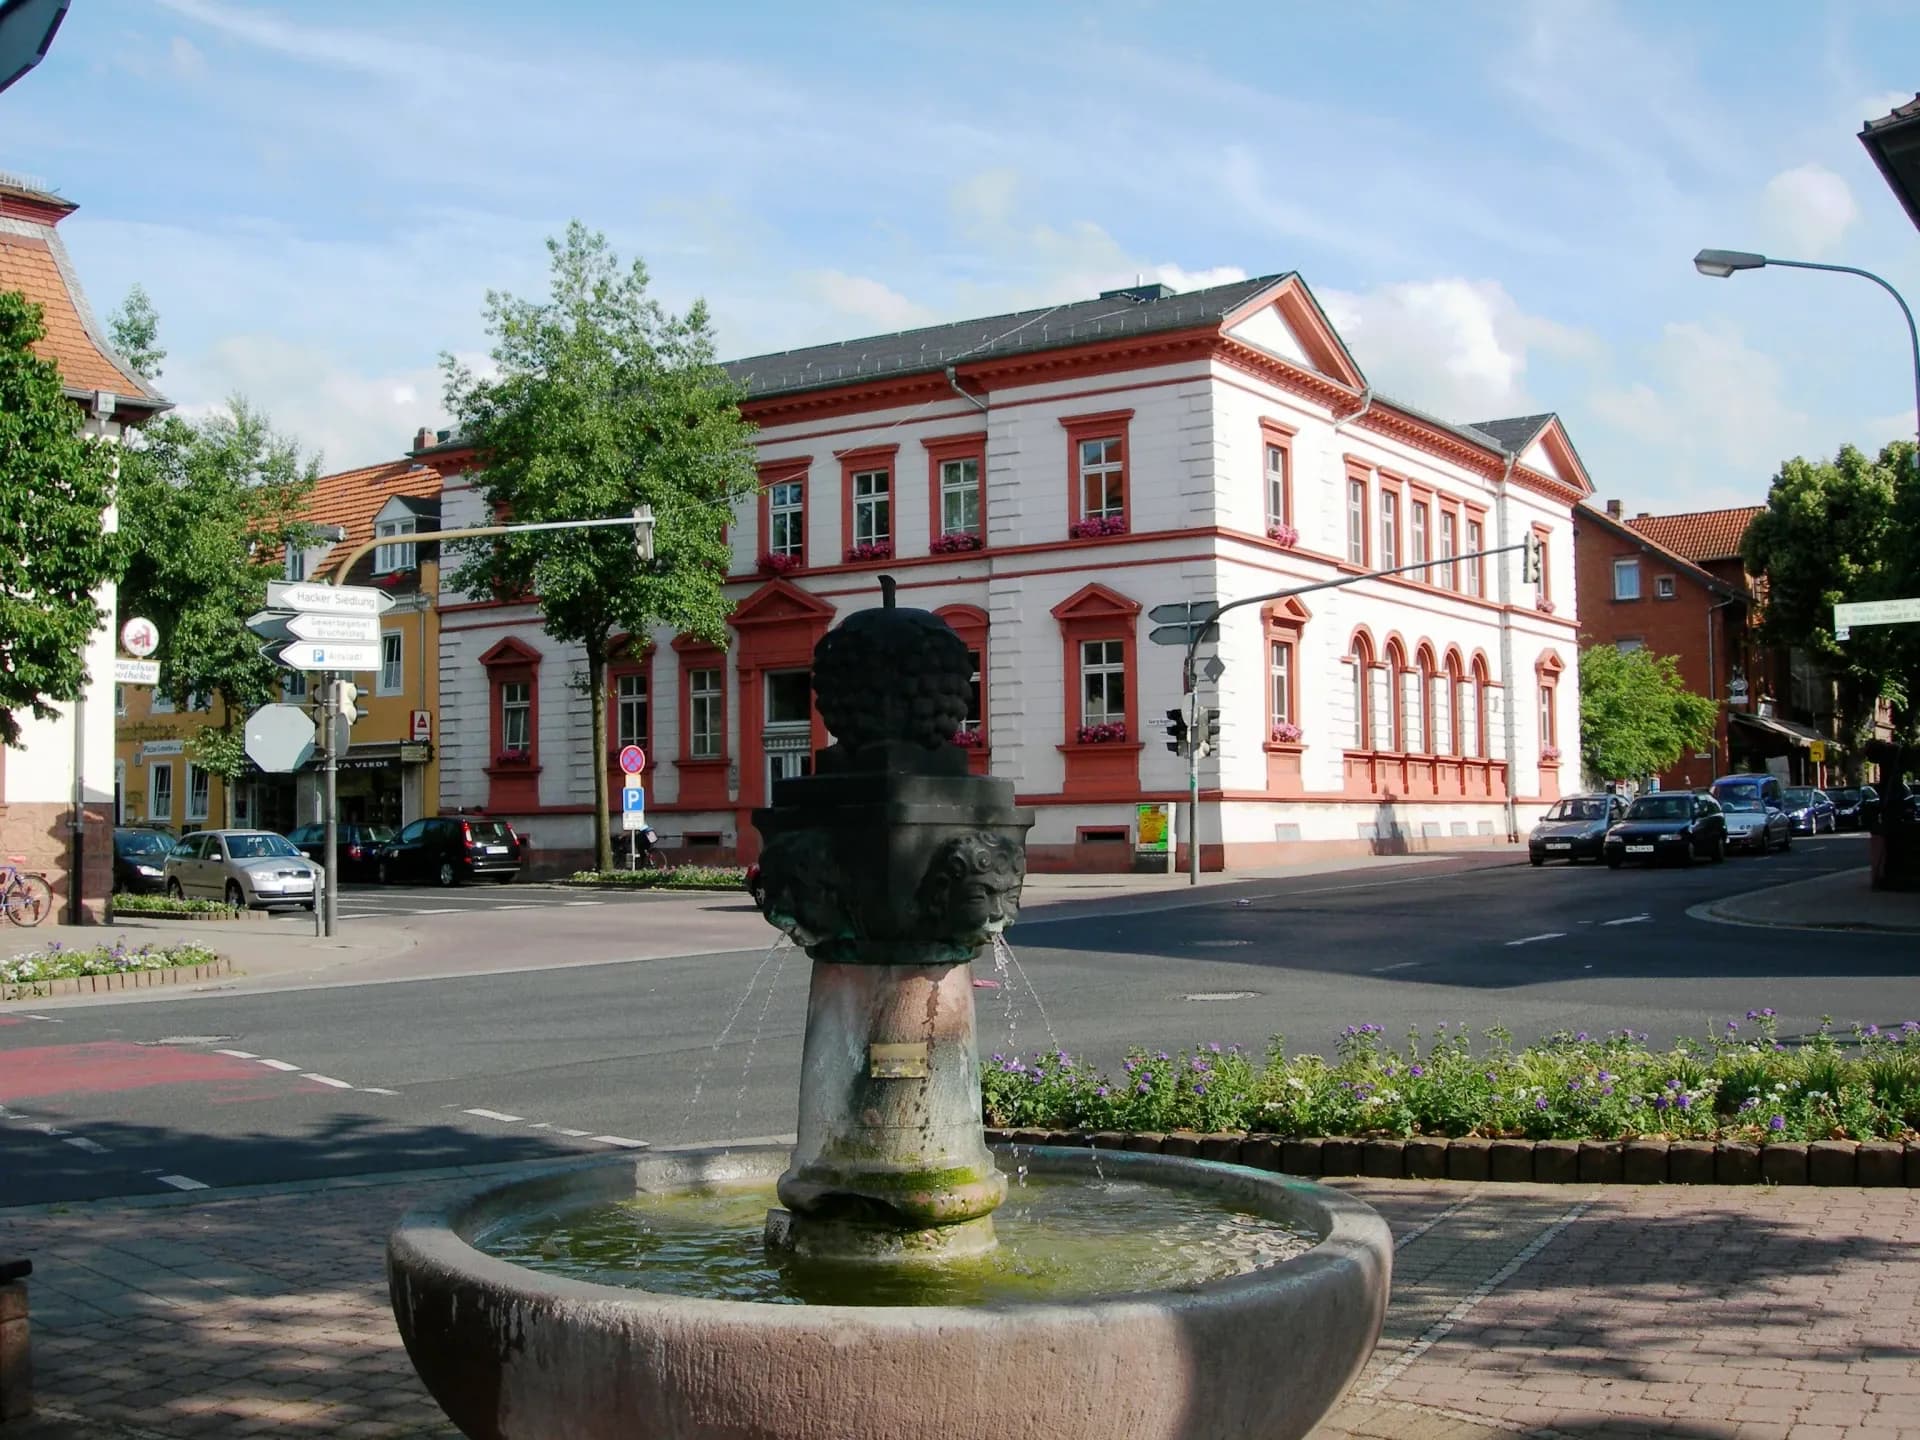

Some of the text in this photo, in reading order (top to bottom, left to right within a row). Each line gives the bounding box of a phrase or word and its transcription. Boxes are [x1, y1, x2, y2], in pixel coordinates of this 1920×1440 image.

[297, 592, 375, 608] Hacker Siedlung
[115, 671, 152, 681] otheke
[627, 790, 639, 809] P
